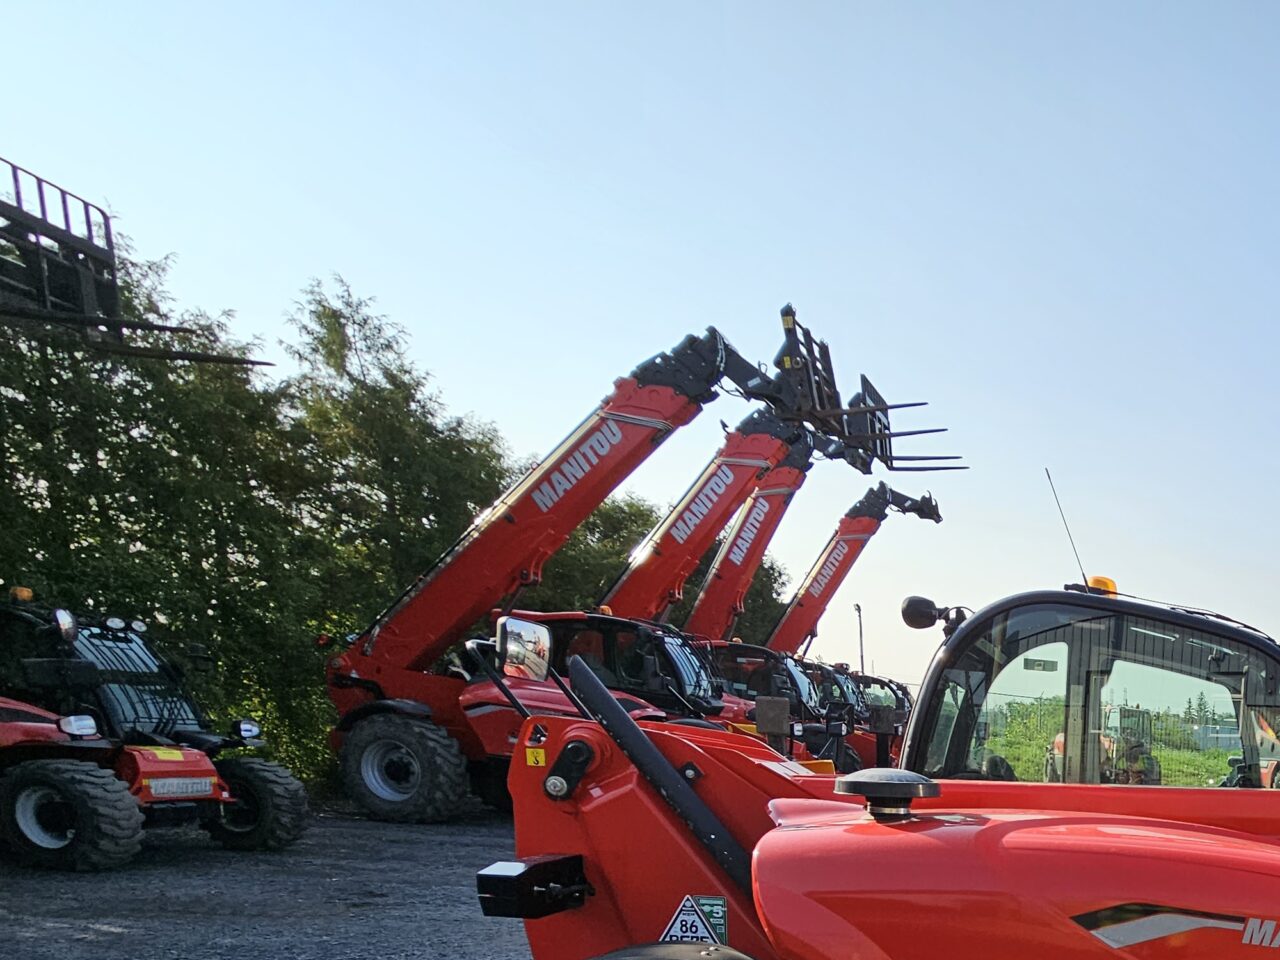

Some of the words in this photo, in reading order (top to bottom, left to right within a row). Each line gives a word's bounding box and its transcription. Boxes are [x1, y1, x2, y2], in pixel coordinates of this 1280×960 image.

[530, 419, 622, 513] MANITOU
[669, 464, 734, 544] MANITOU
[728, 496, 770, 566] MANITOU
[808, 540, 849, 598] MANITOU
[679, 919, 698, 934] 86
